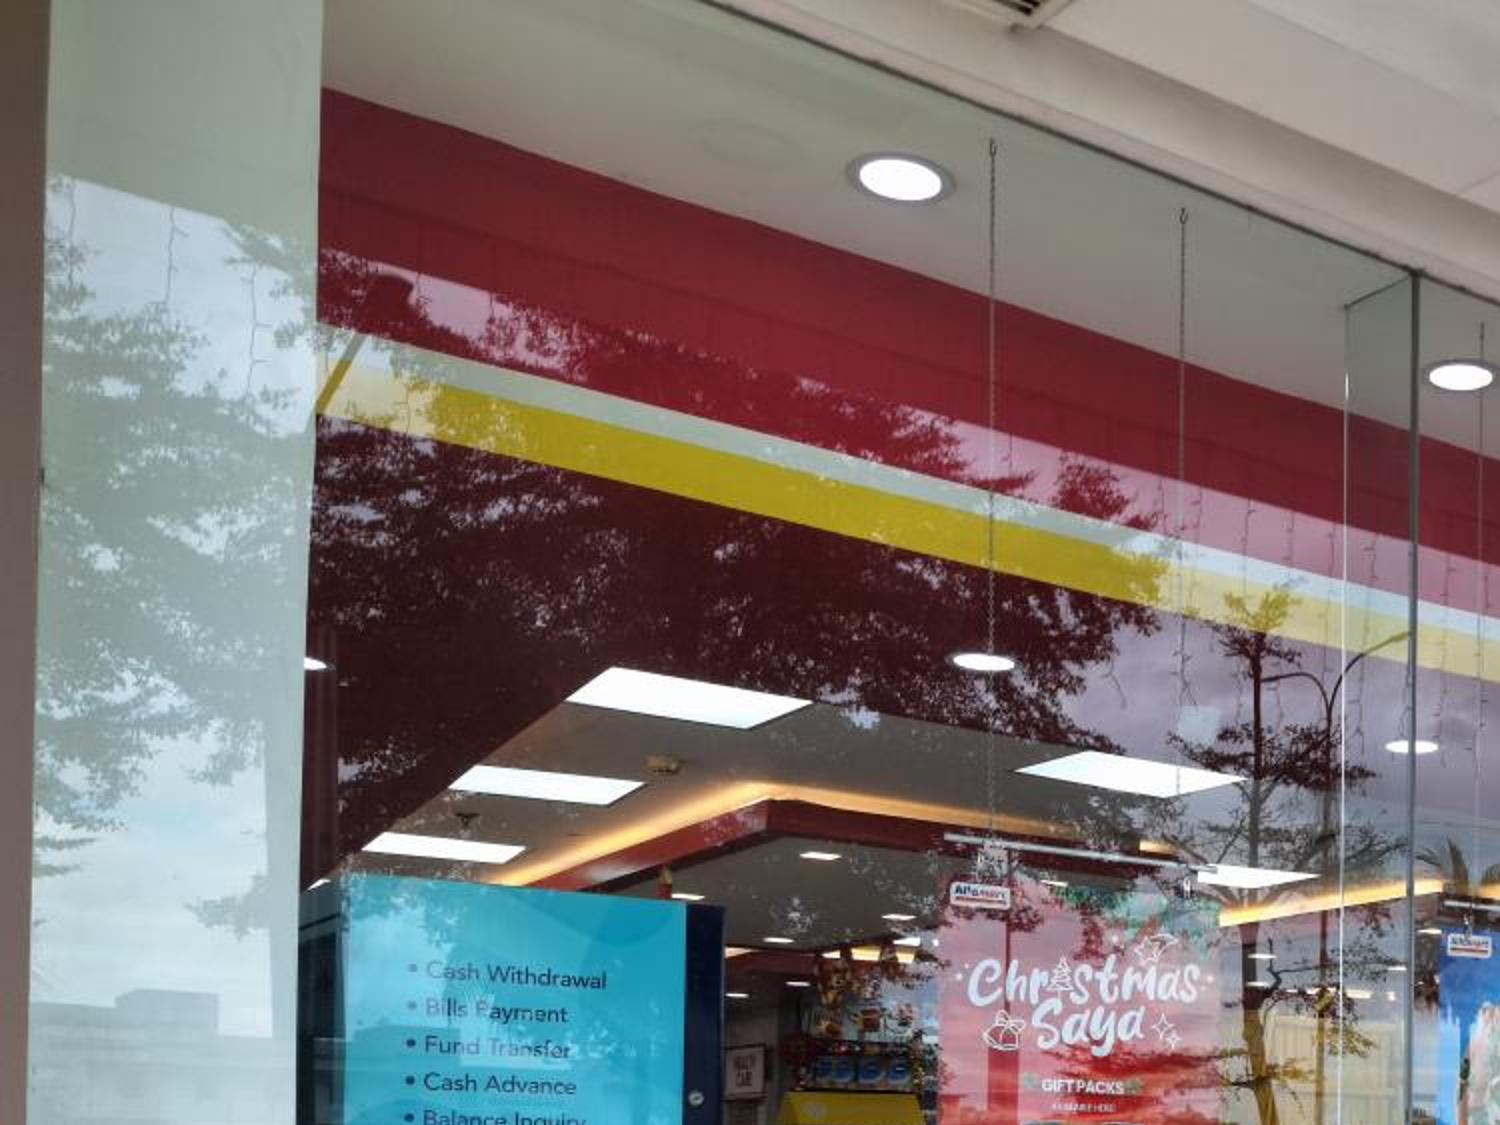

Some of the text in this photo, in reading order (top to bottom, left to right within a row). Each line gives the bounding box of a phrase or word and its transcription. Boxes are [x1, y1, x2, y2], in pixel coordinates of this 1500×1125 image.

[426, 961, 608, 990] Cash Withdrawal
[425, 997, 568, 1024] Bills Payment
[1031, 996, 1147, 1057] Saya
[424, 1035, 571, 1060] Fund Transfer
[423, 1073, 577, 1096] Cash Advance
[1041, 1077, 1126, 1095] GIFT PACKS
